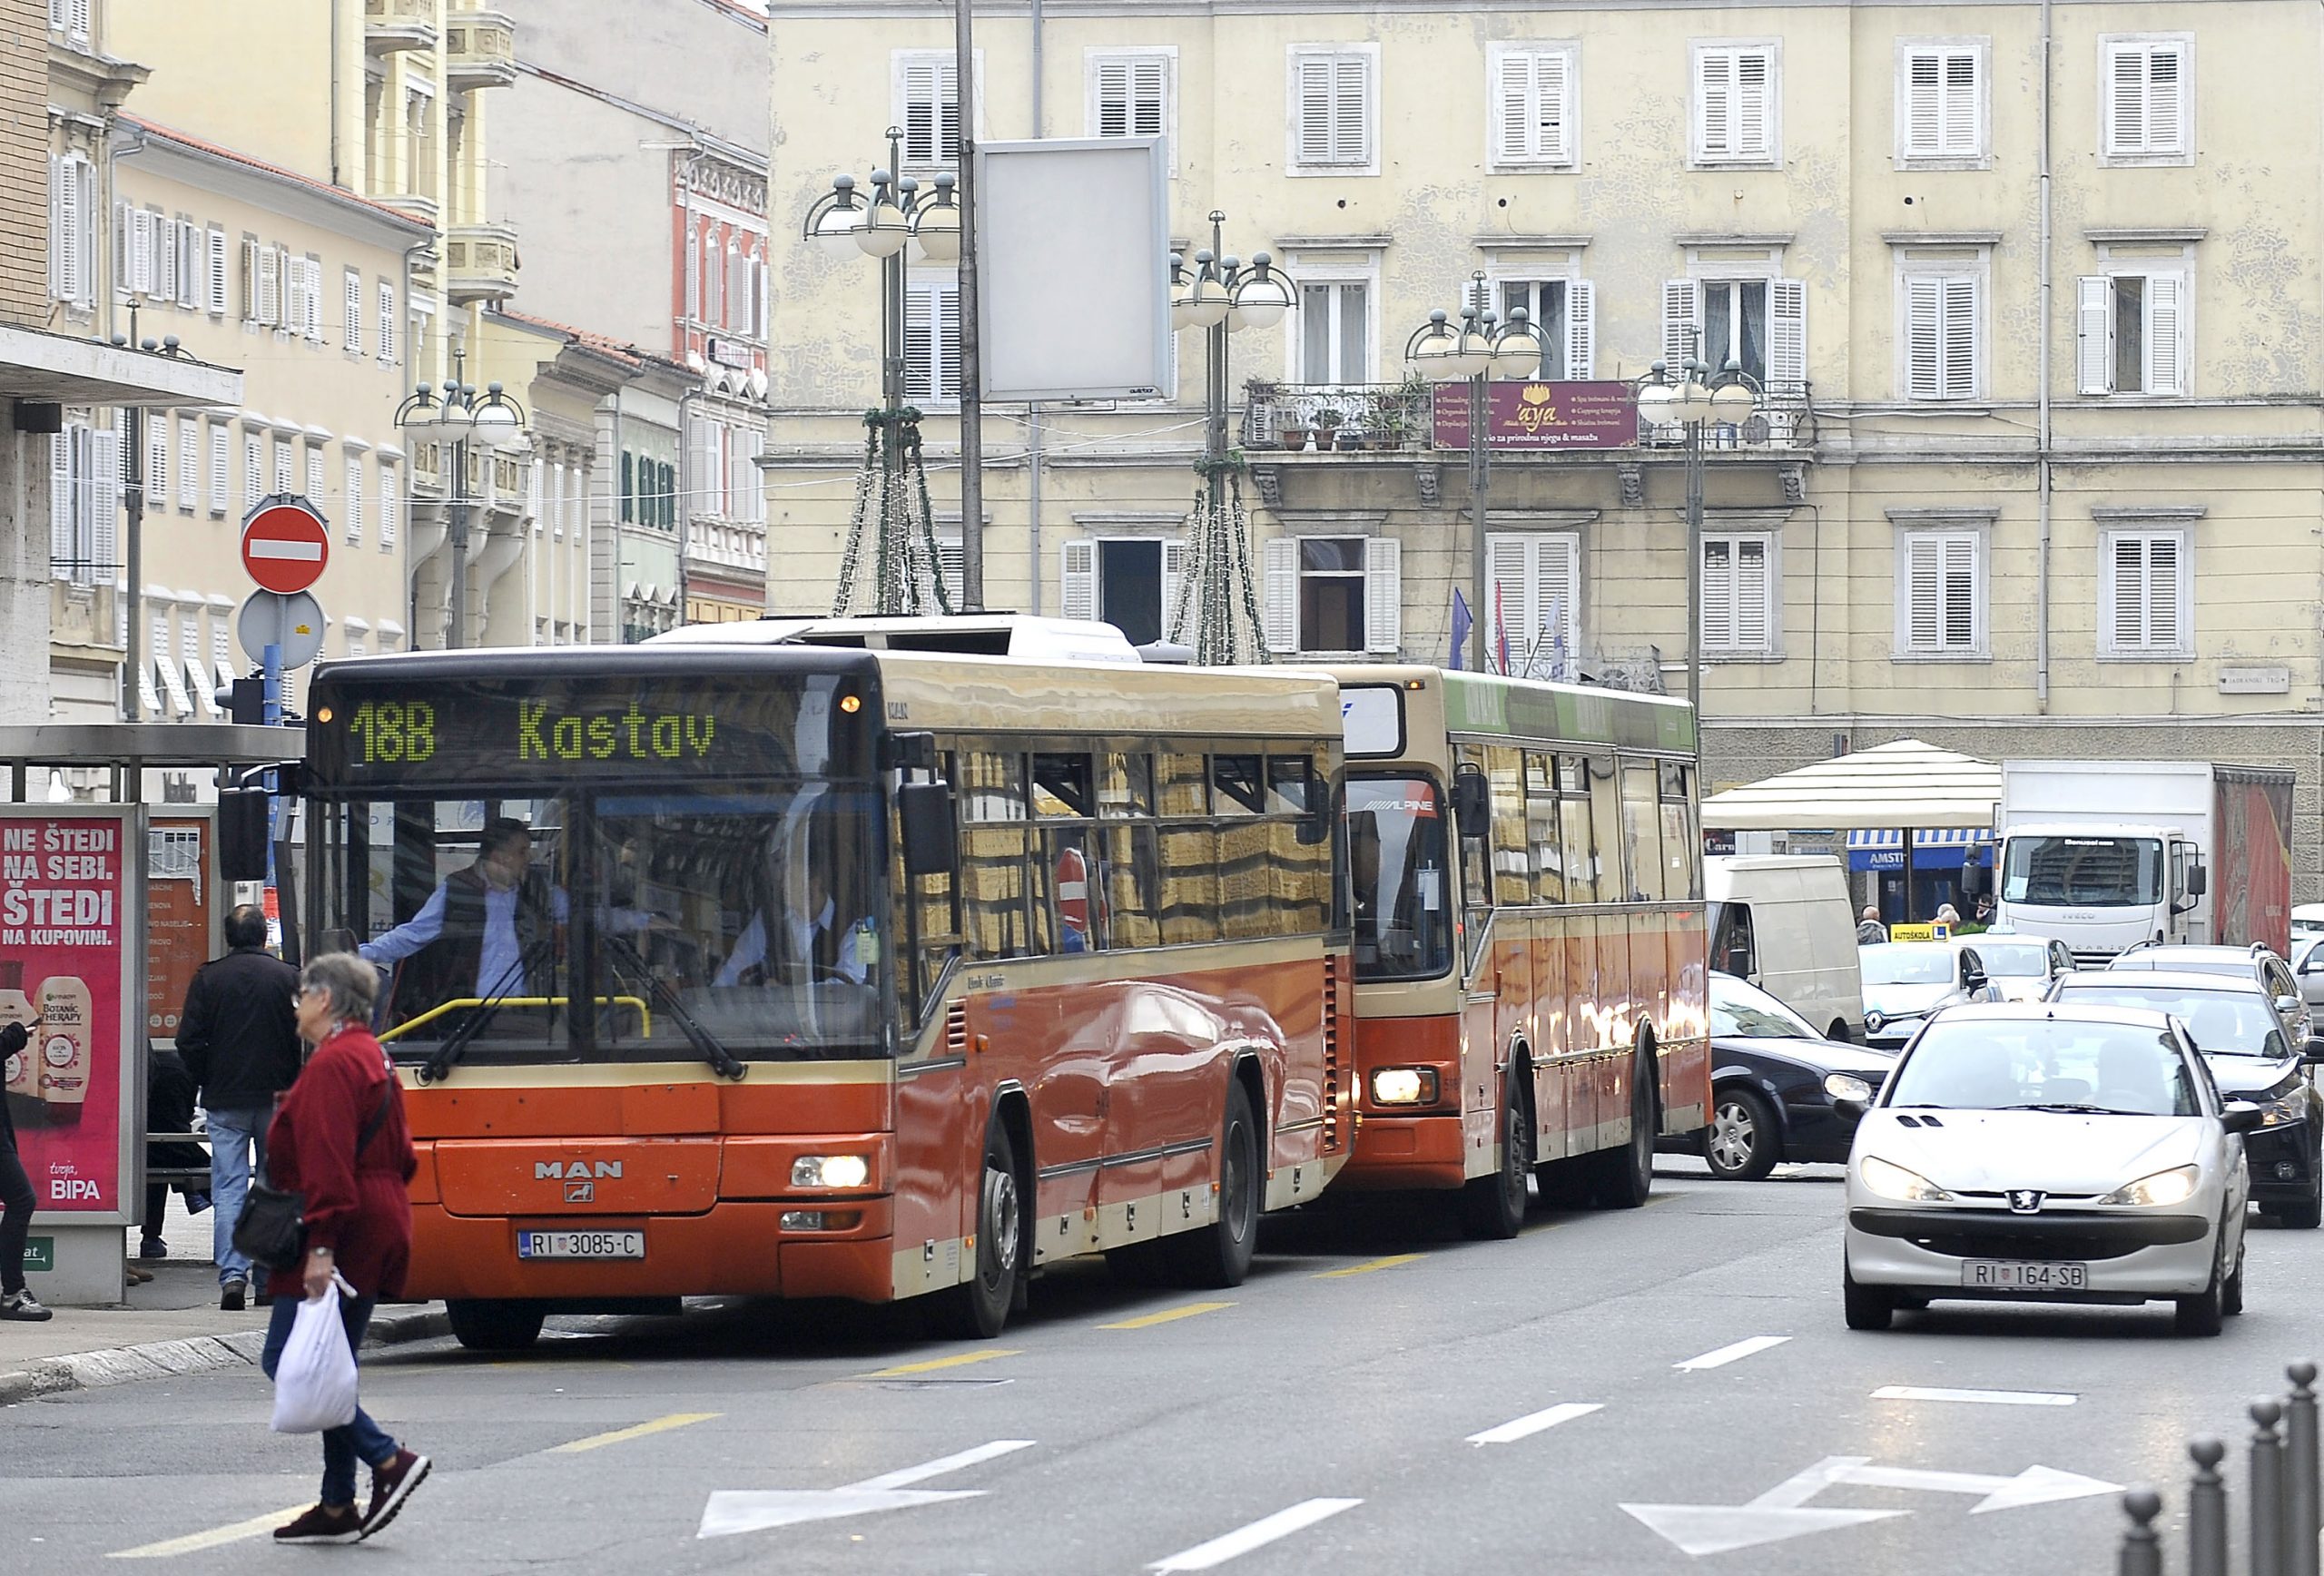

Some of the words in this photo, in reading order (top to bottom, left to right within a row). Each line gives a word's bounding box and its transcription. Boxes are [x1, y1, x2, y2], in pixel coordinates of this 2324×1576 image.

[350, 702, 435, 763] 18B
[519, 700, 714, 759] Kastav
[1384, 800, 1433, 812] ALPINE
[4, 828, 37, 852] NE
[44, 822, 114, 852] ŠTEDI
[3, 855, 40, 881] NA
[47, 855, 113, 881] SEBI.
[3, 880, 113, 926] ŠTEDI
[2, 929, 26, 945] NA
[30, 929, 113, 946] KUPOVINI.
[1894, 931, 1931, 941] AUTOŠKOLA
[535, 1161, 623, 1179] MAN
[51, 1179, 101, 1199] BIPA
[532, 1235, 553, 1254] RI
[568, 1235, 635, 1254] 3085-C
[1976, 1266, 1996, 1284] RI
[2017, 1266, 2083, 1285] 164-SB
